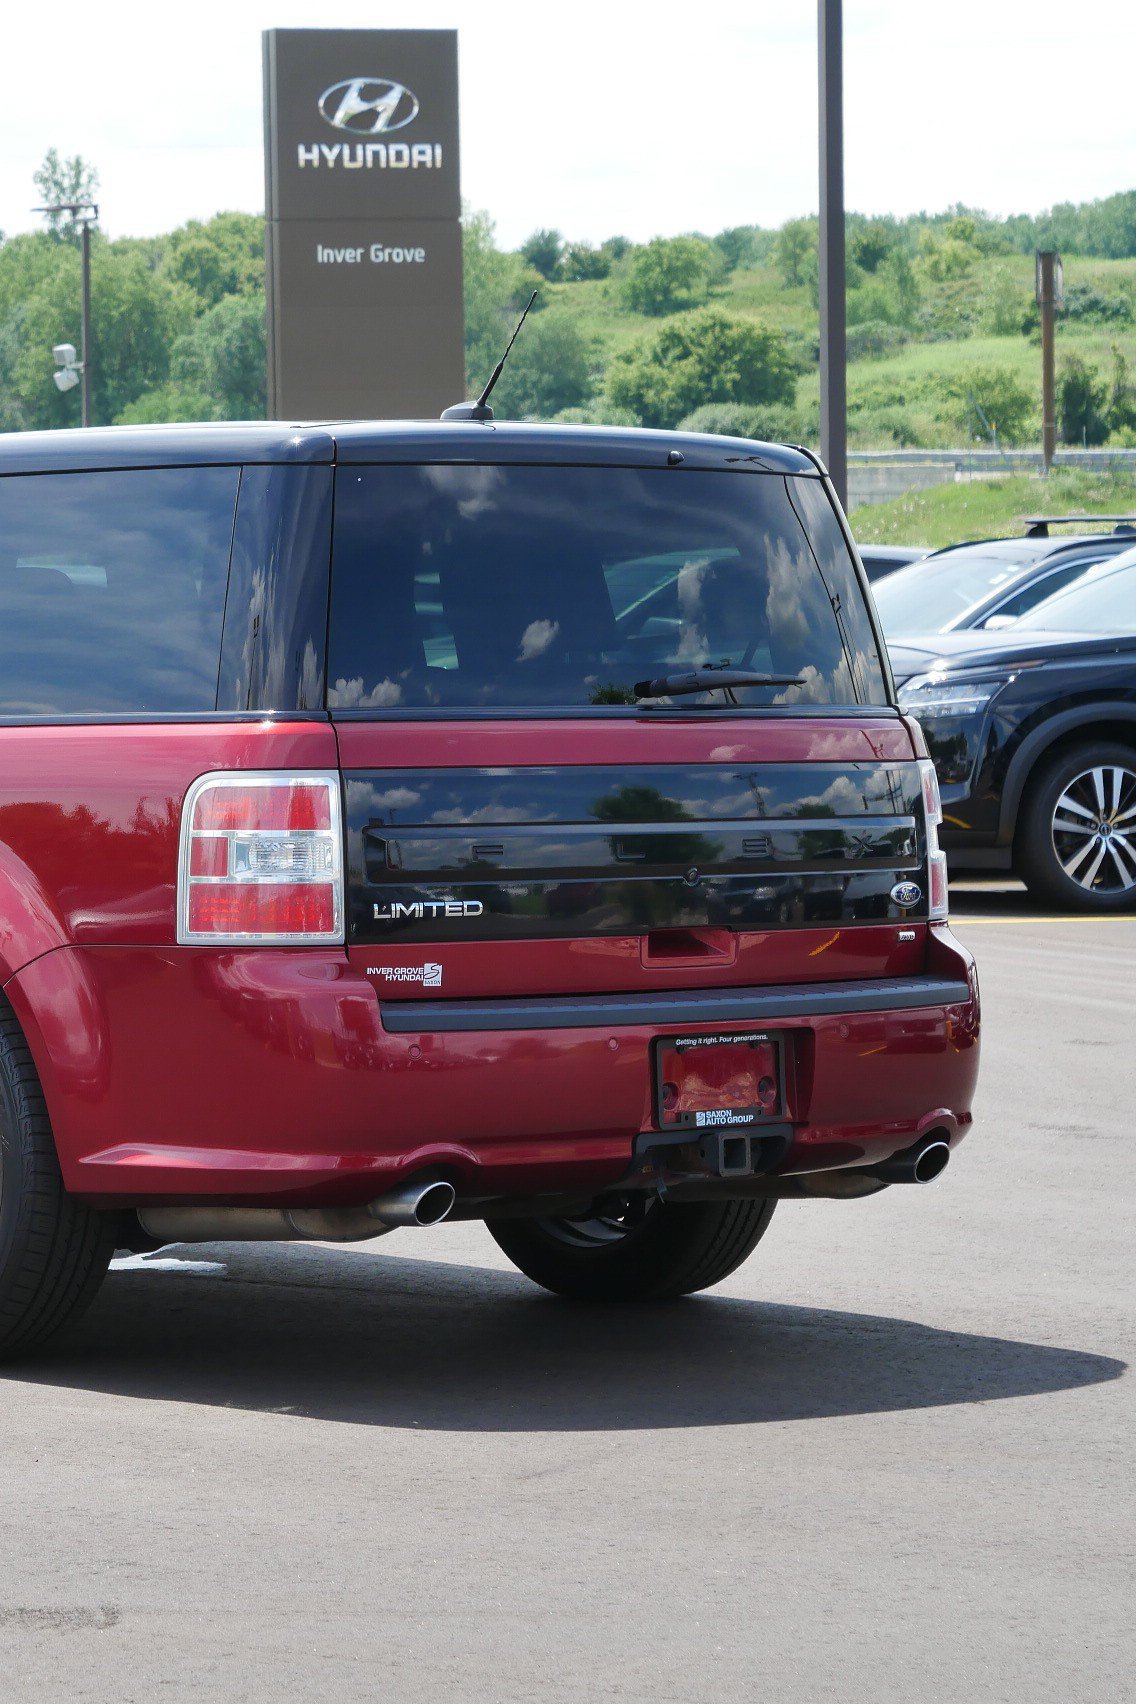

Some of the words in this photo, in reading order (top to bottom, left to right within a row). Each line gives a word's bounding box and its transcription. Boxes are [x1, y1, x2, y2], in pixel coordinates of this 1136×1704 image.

[297, 143, 442, 168] HYUNDAI
[317, 244, 364, 263] Inver
[370, 243, 425, 263] Grove
[373, 901, 483, 919] LIMITED
[366, 967, 393, 975] INVER
[394, 967, 424, 975] GROVE
[385, 974, 424, 982] HYUNDAI
[675, 1038, 697, 1046] Getting
[733, 1034, 769, 1043] generations.
[706, 1110, 732, 1118] SAXON
[706, 1117, 726, 1125] AUTO
[727, 1115, 754, 1124] GROUP
